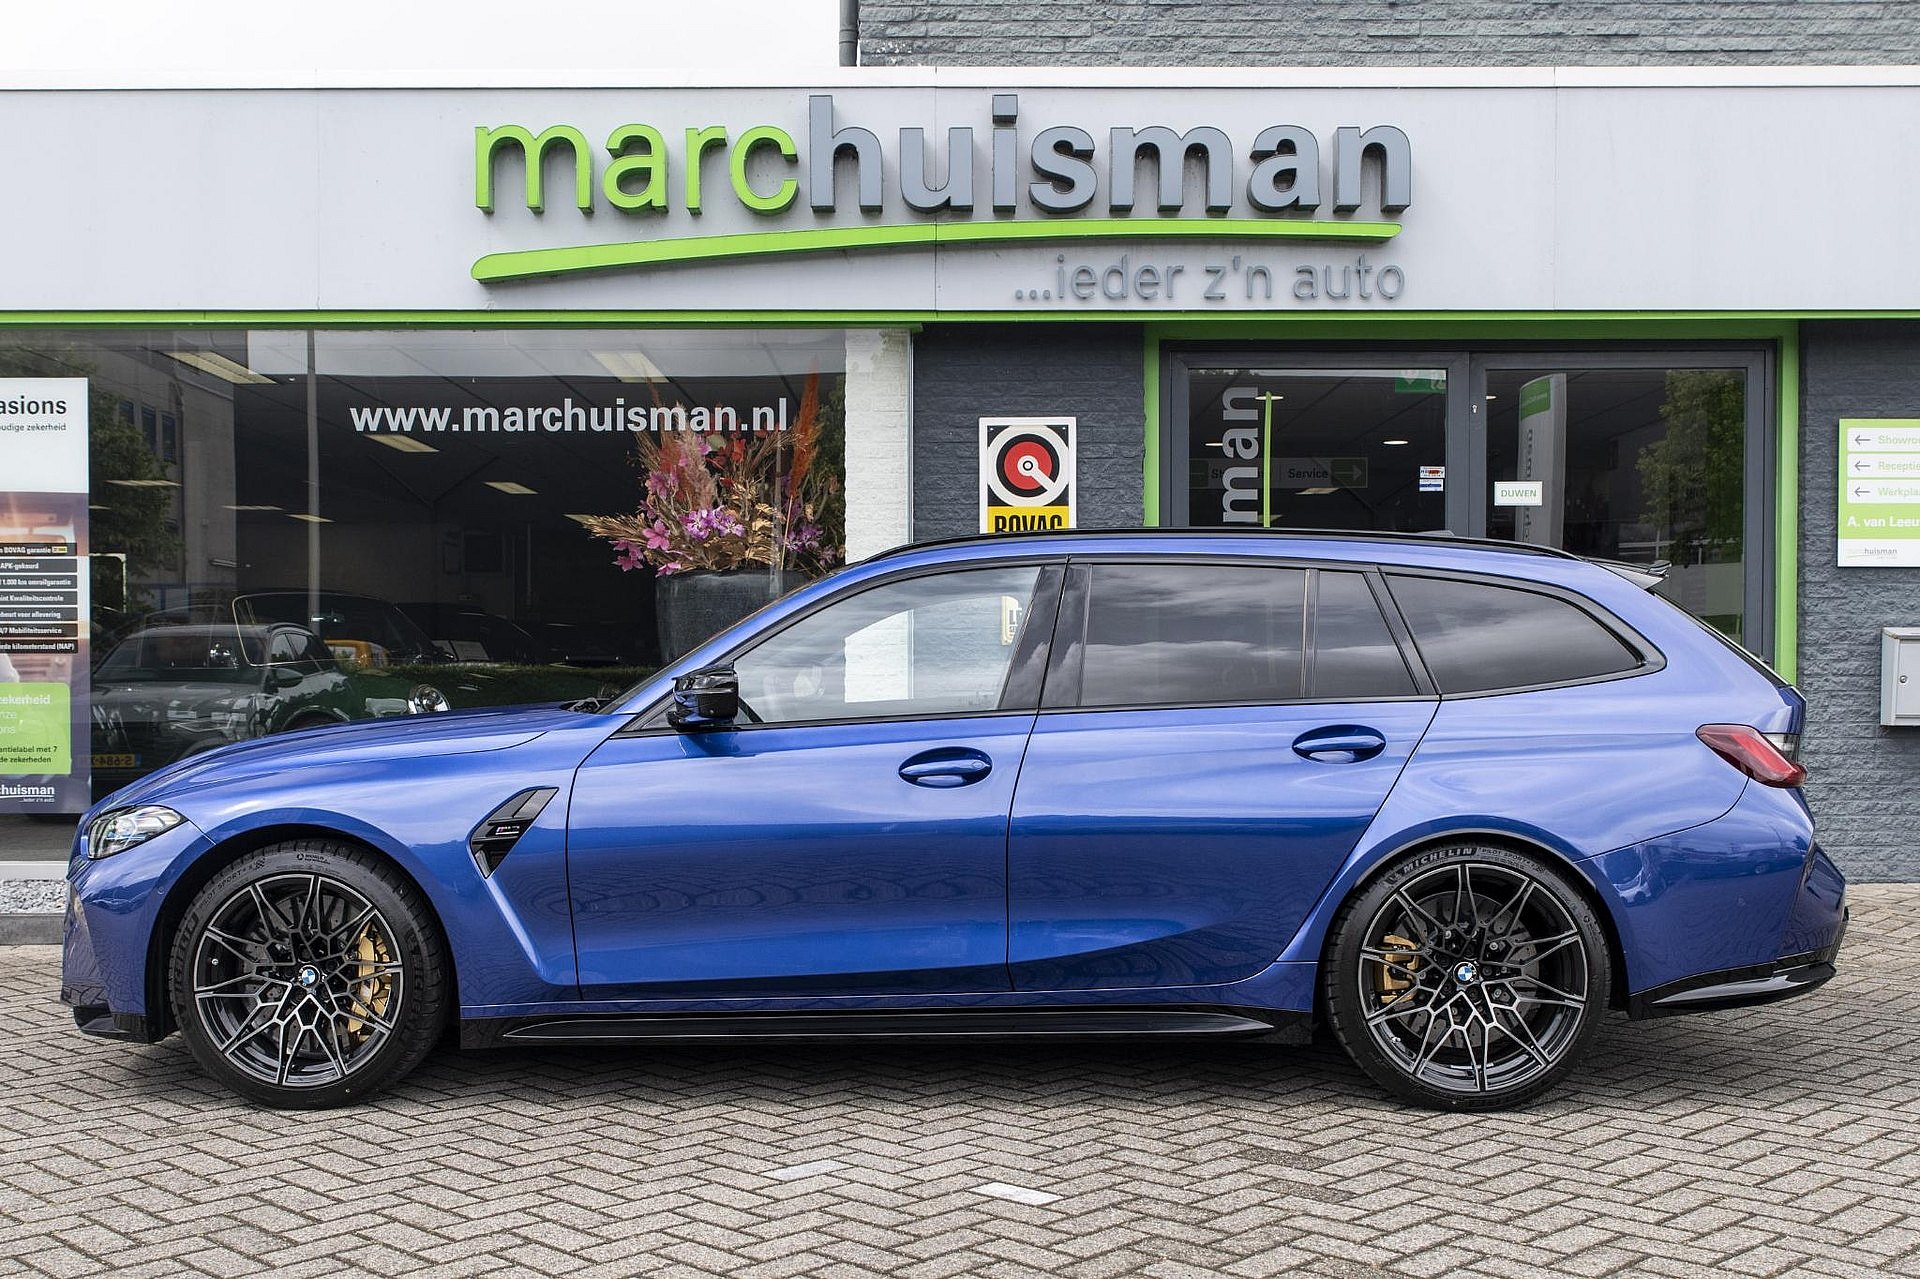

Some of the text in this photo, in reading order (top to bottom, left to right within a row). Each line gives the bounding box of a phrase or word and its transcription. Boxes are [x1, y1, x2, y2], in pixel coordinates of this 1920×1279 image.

[474, 94, 1412, 214] marchuisman
[1203, 255, 1273, 300] z'n
[1293, 254, 1406, 300] auto
[349, 397, 788, 432] www.marchuisman.nl
[0, 423, 66, 432] udige zekerheid
[1287, 467, 1329, 479] Service
[1500, 489, 1537, 498] DUWEN
[1847, 516, 1860, 528] A.
[1864, 518, 1886, 528] van
[0, 784, 55, 795] huisman
[1403, 848, 1473, 874] MICHELIN
